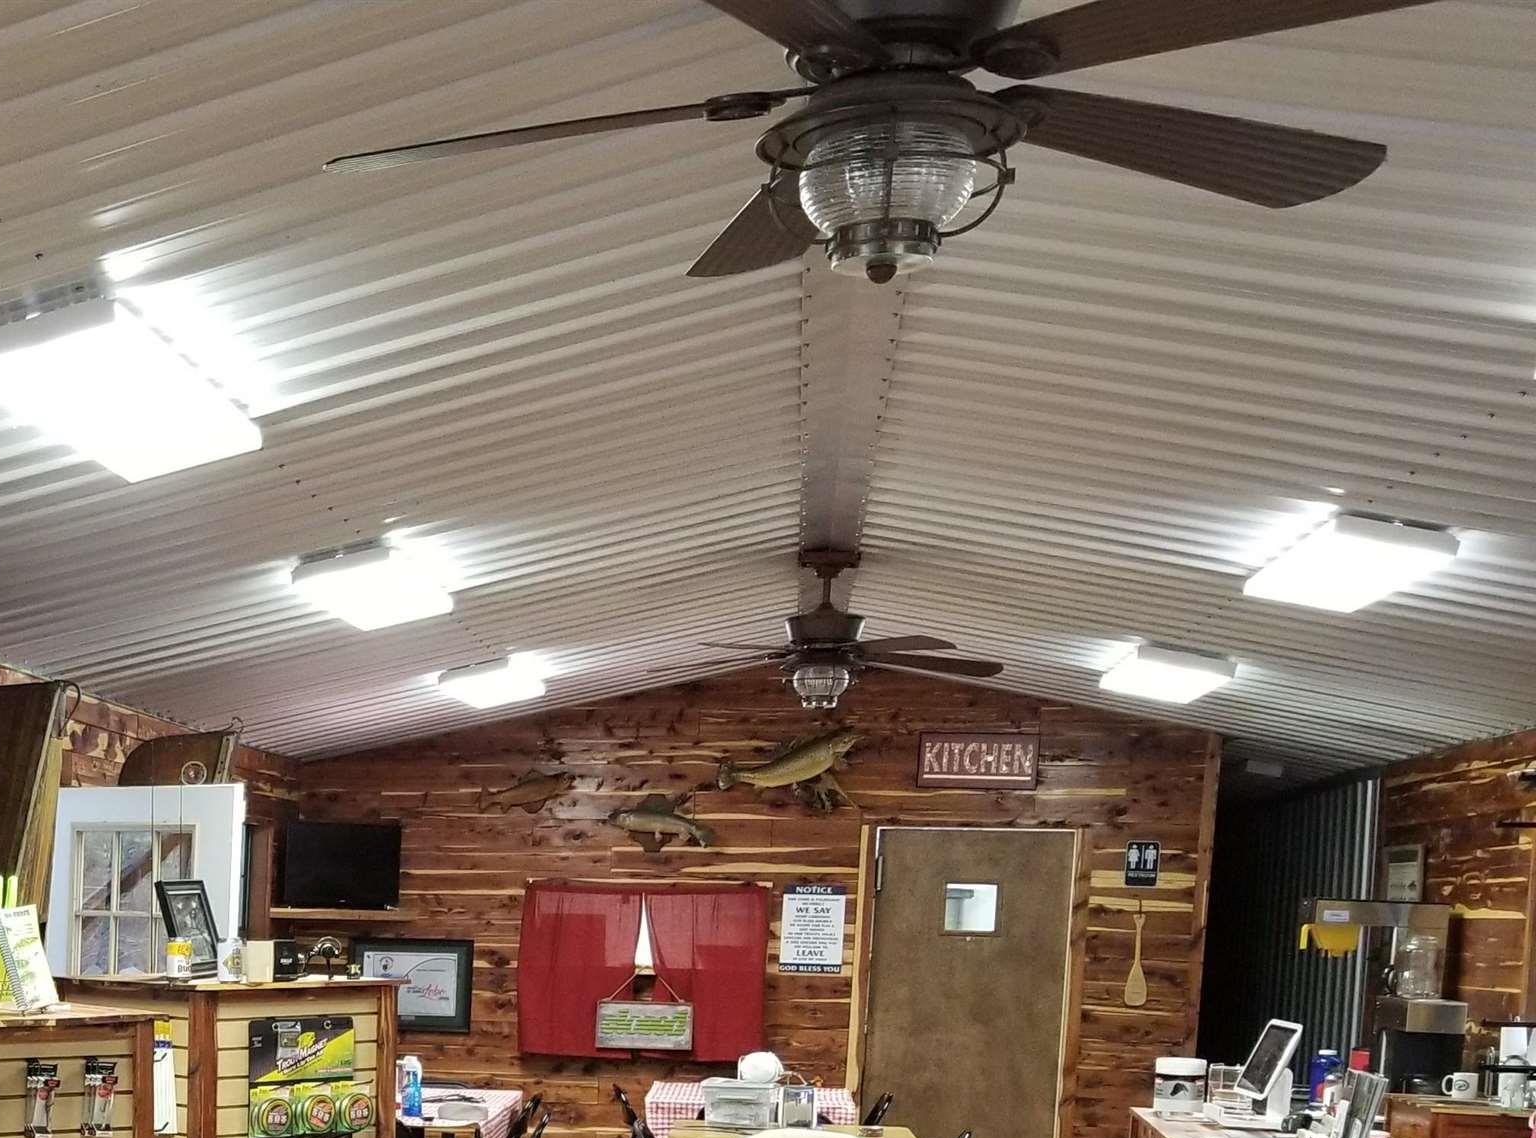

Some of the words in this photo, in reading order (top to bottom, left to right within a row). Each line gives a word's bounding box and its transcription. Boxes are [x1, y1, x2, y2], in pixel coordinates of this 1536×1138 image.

[924, 742, 1034, 774] KITCHEN
[795, 886, 833, 894] NOTICE
[796, 906, 811, 914] WE
[796, 949, 825, 957] LEAVE
